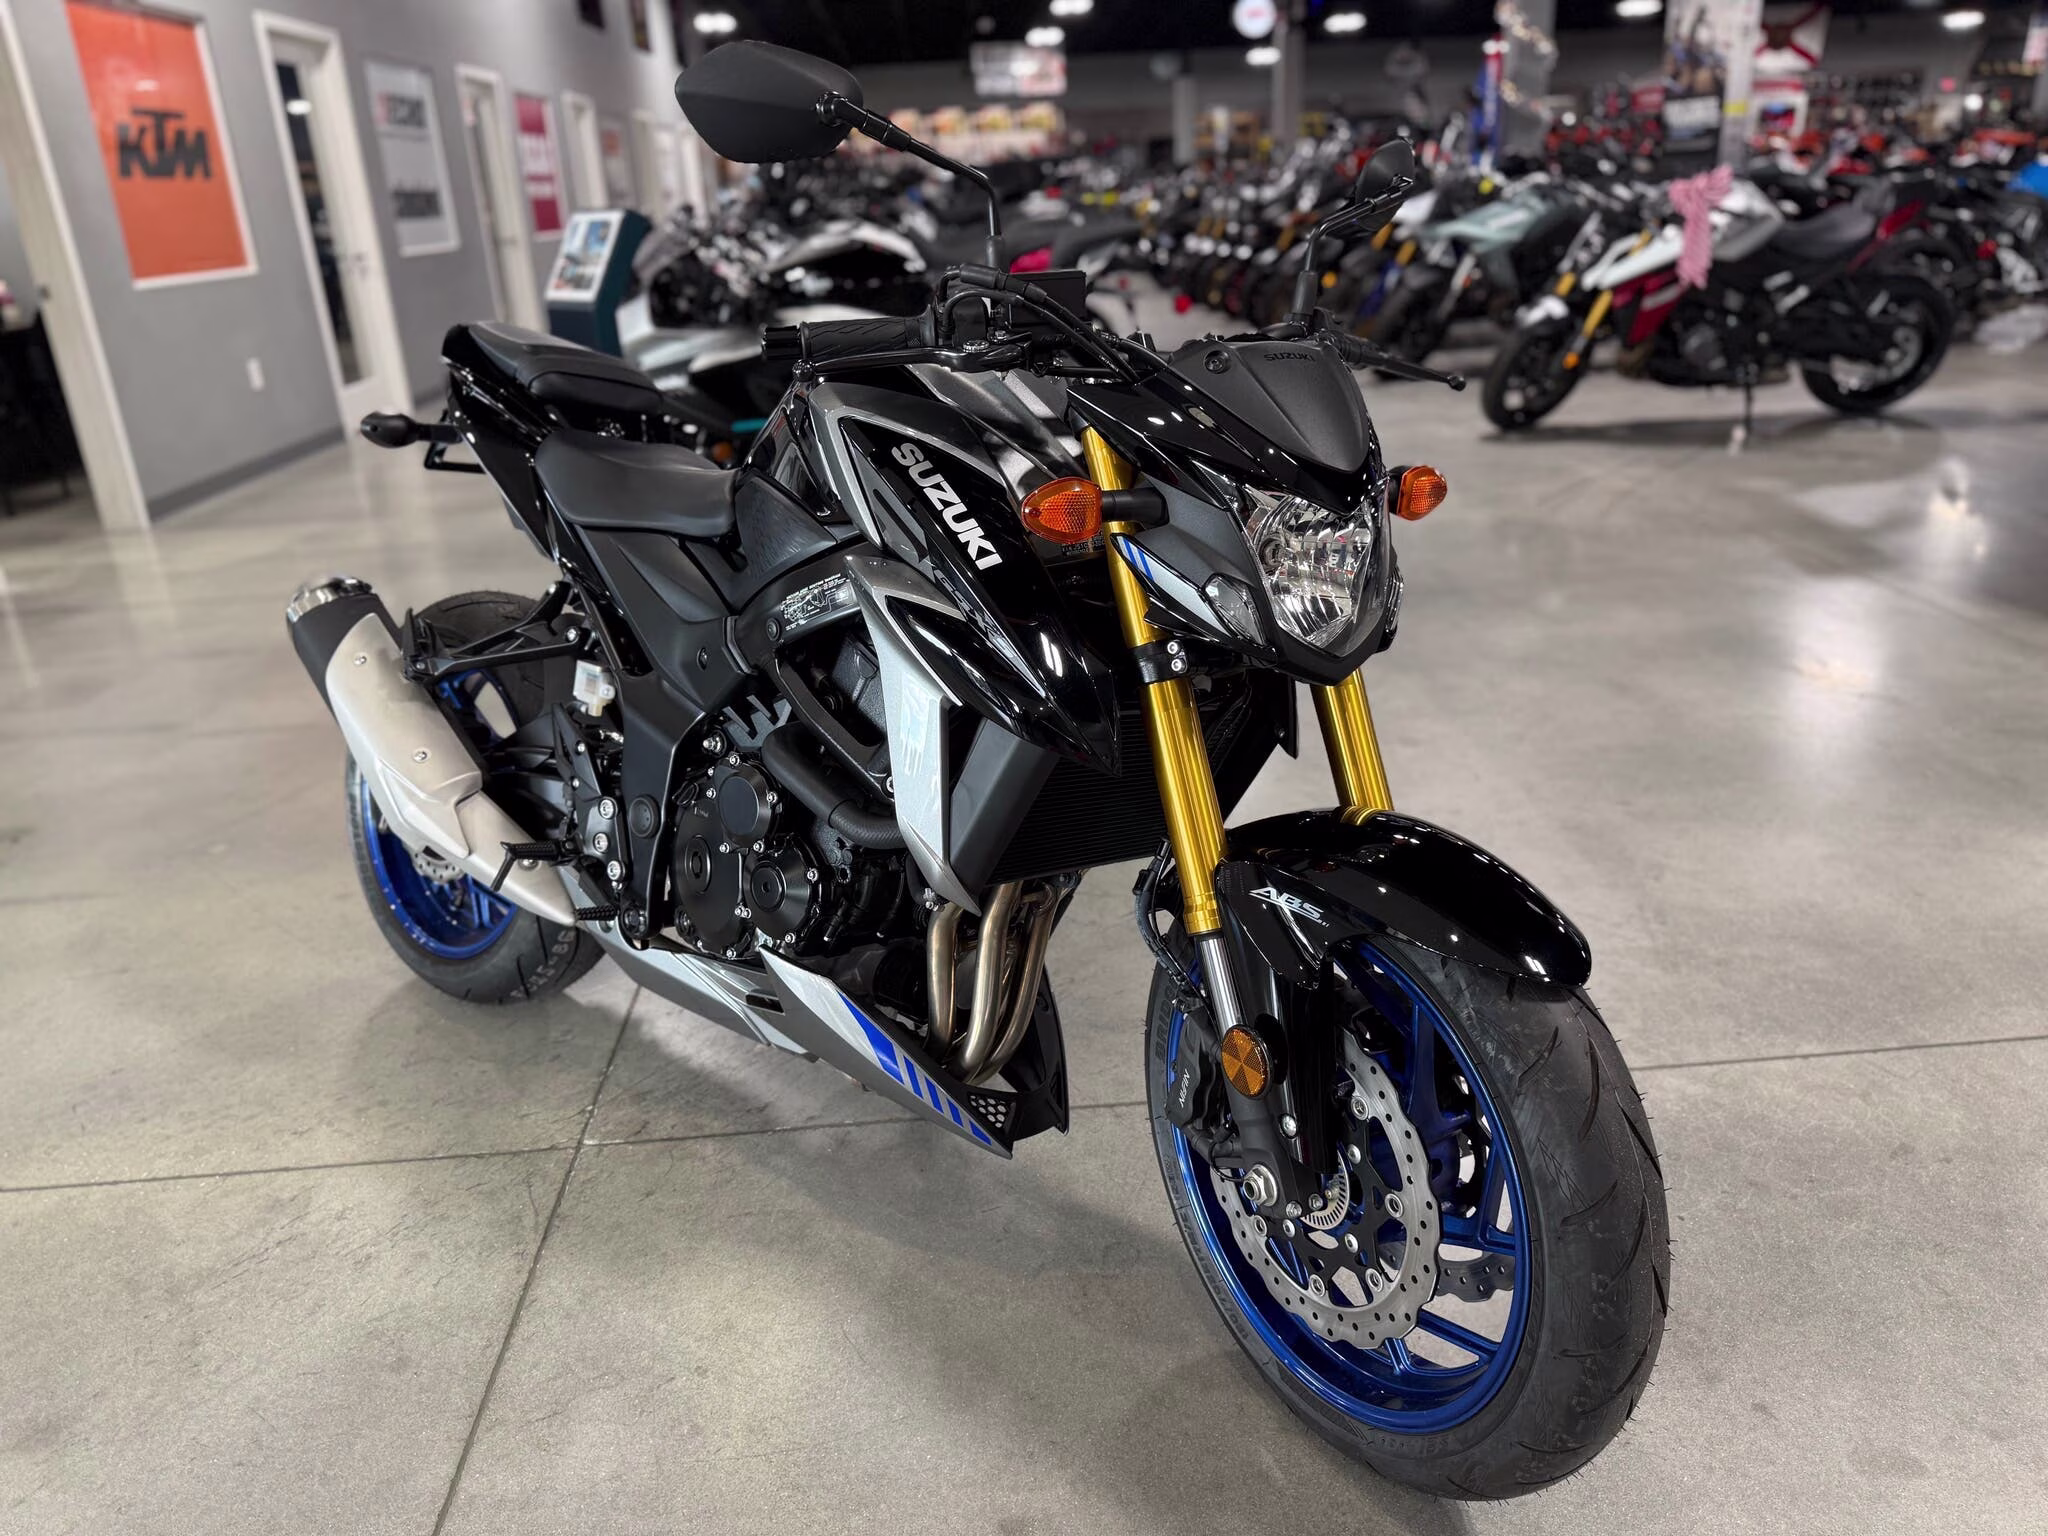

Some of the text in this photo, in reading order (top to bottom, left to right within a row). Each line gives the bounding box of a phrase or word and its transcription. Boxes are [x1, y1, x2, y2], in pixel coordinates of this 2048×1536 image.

[116, 107, 212, 179] KTM
[1263, 352, 1316, 361] SUZUKI
[891, 443, 1003, 570] SUZUKI
[1248, 886, 1325, 920] ABS
